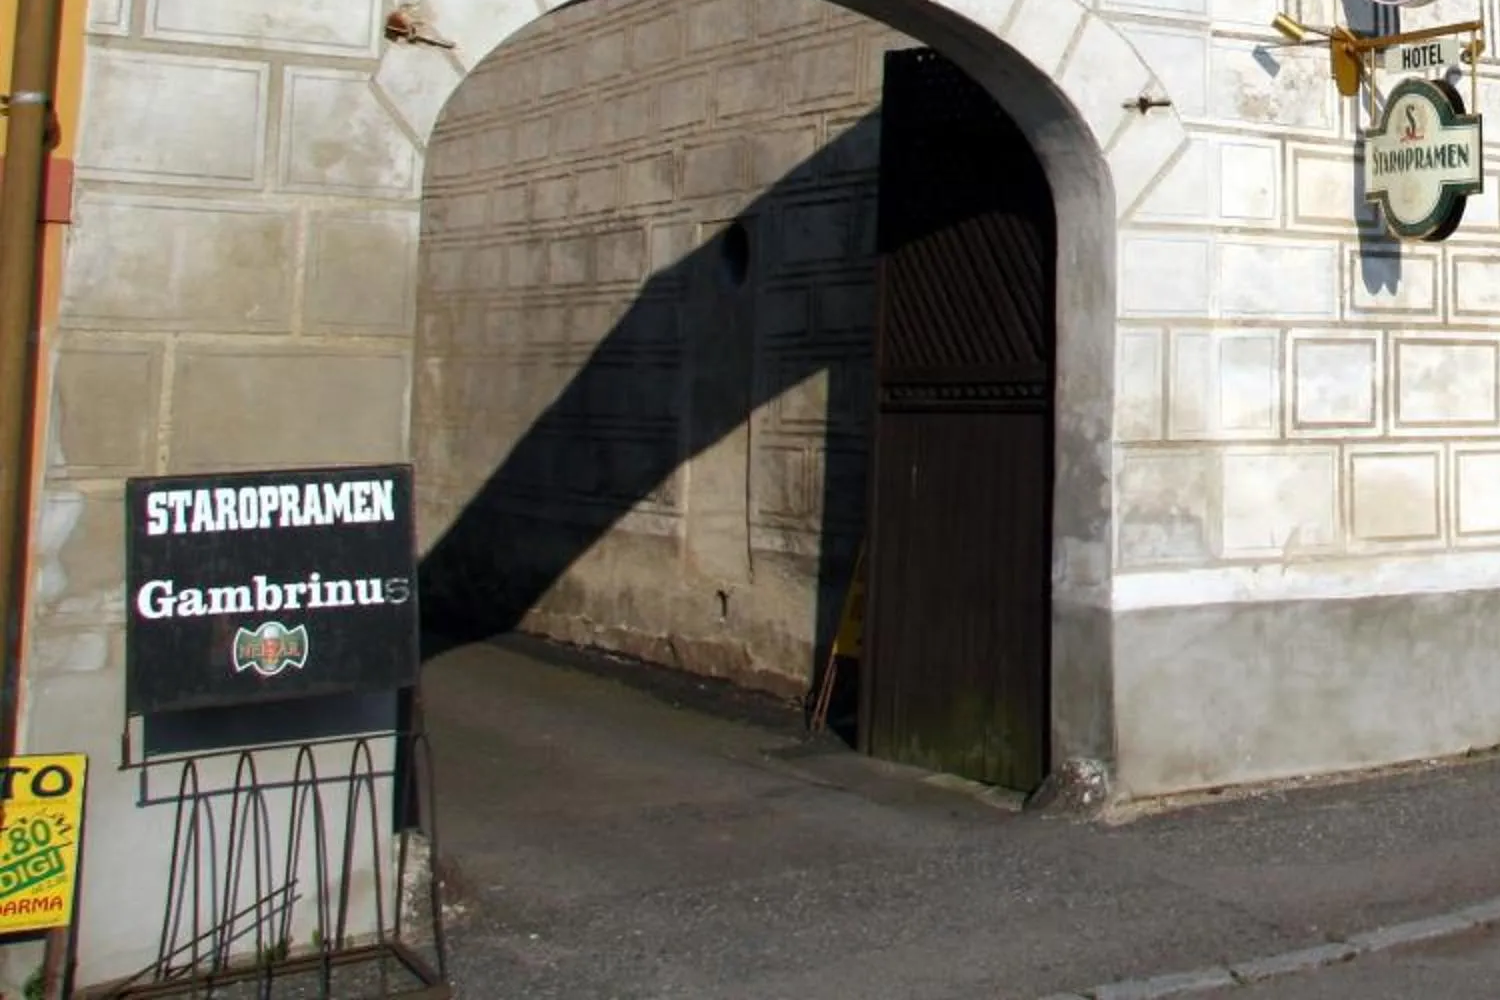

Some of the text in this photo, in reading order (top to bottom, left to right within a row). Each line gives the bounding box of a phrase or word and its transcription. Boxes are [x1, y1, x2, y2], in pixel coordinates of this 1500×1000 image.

[1402, 43, 1444, 69] HOTEL
[1372, 143, 1470, 176] STAROPRAMEN
[147, 480, 395, 536] STAROPRAMEN
[137, 572, 410, 619] Gambrinus
